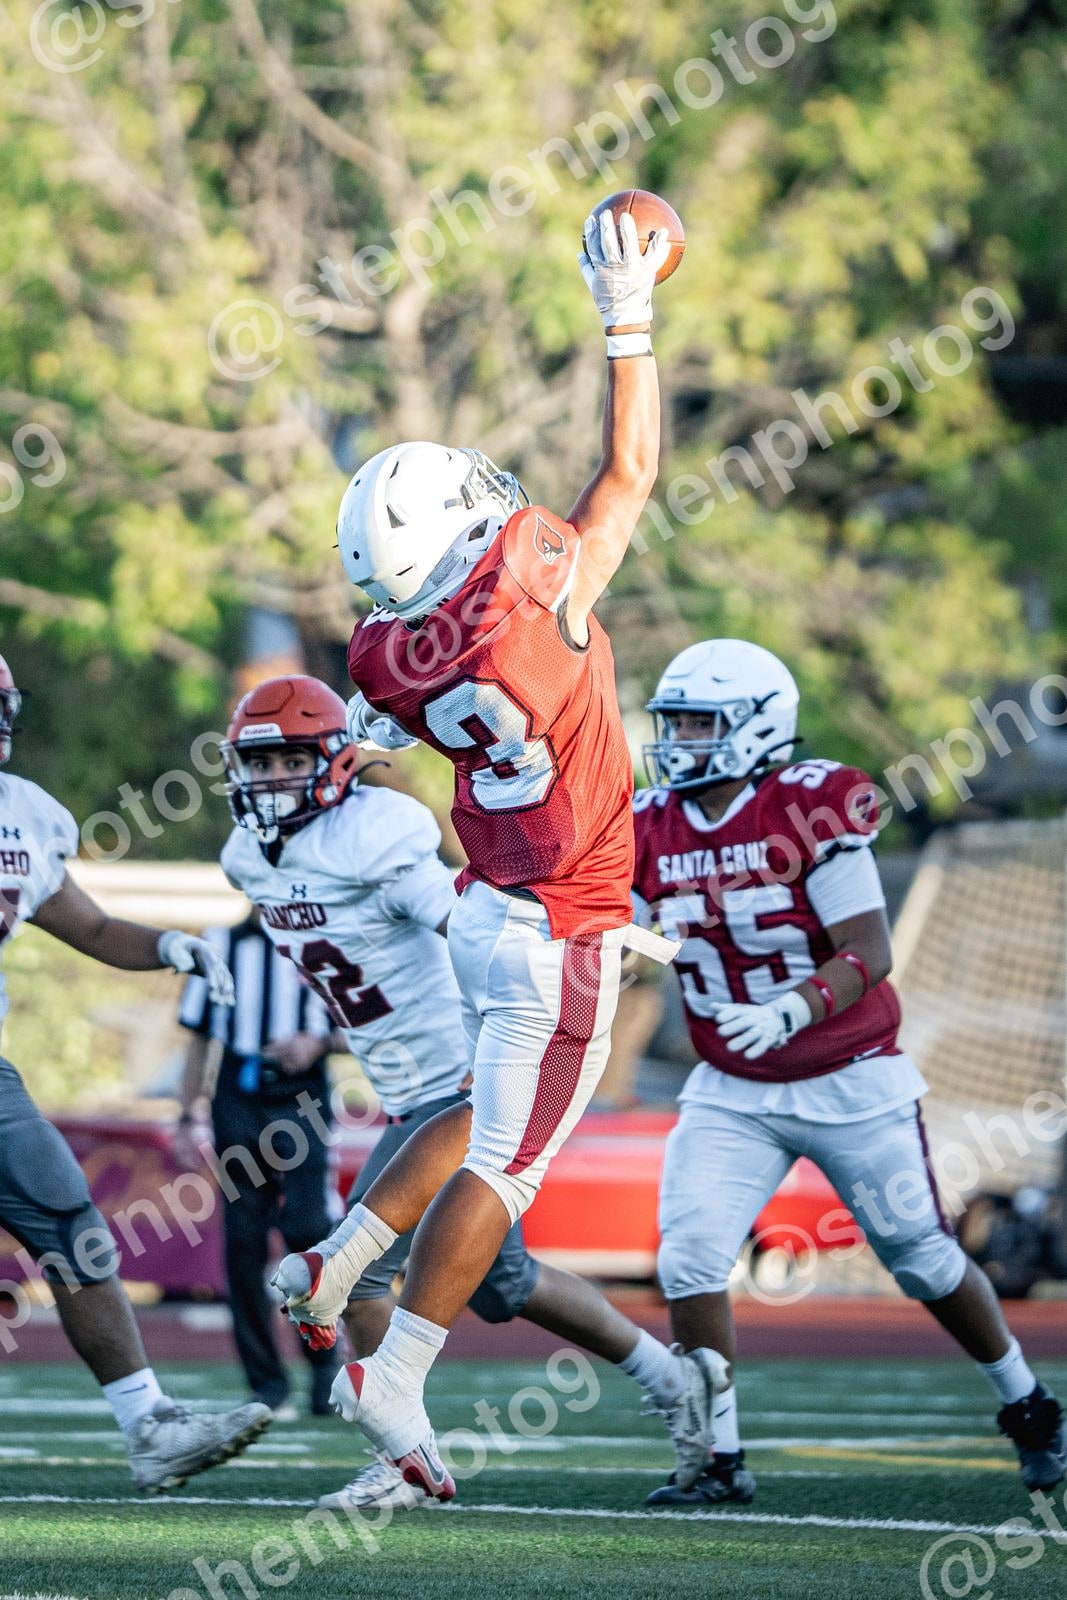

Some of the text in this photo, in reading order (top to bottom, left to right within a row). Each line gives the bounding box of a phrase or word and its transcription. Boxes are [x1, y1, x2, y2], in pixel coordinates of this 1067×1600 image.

[421, 677, 558, 813] 3
[657, 841, 769, 885] SANTA CRUZ
[275, 939, 394, 1028] 2
[660, 882, 816, 1018] 55
